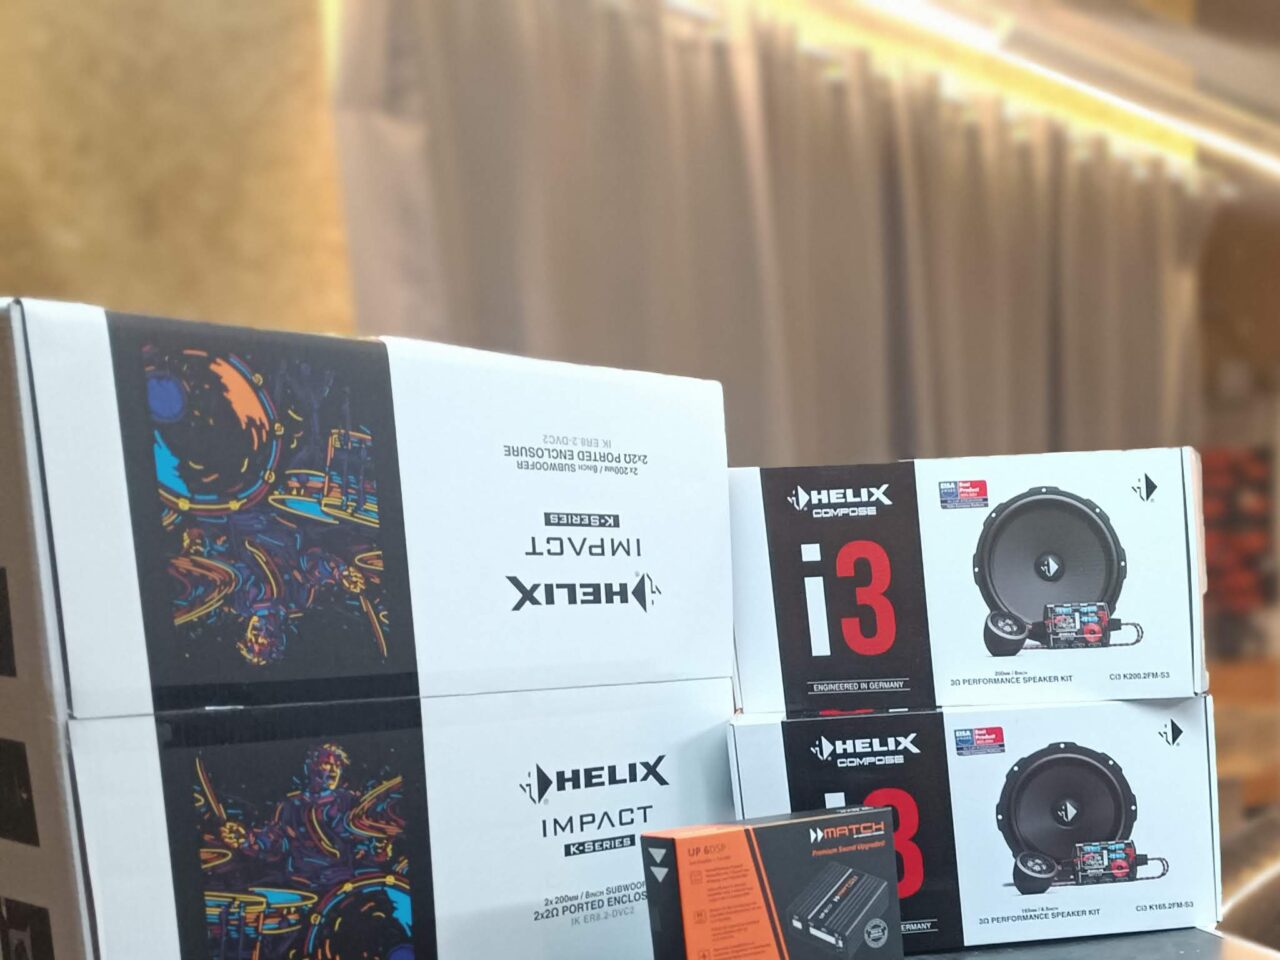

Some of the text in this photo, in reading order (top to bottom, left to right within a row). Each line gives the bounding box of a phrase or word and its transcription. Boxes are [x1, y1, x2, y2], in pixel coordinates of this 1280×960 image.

[503, 445, 575, 460] ENCLOSURE
[577, 450, 621, 464] PORTED
[516, 460, 576, 472] SUBWOOFER
[810, 484, 893, 505] HELIX
[812, 506, 877, 518] COMPOSE
[525, 536, 641, 557] IMPACT
[505, 576, 629, 611] HELIX
[800, 539, 897, 657] i3
[813, 681, 904, 692] ENGINEERED IN GERMANY
[962, 677, 1021, 686] PERFORMANCE
[1023, 675, 1059, 684] SPEAKER
[835, 733, 921, 754] HELIX
[836, 755, 905, 767] COMPOSE
[556, 754, 670, 792] HELIX
[541, 805, 653, 838] IMPACT
[823, 820, 885, 839] MATCH
[688, 847, 701, 857] UP
[605, 881, 646, 896] SUBWOOF
[562, 898, 605, 915] PORTED
[607, 890, 648, 907] ENCLOS
[991, 912, 1050, 924] PERFORMANCE
[1051, 909, 1087, 919] SPEAKER
[1088, 908, 1101, 916] KIT
[901, 922, 931, 931] ERMANY
